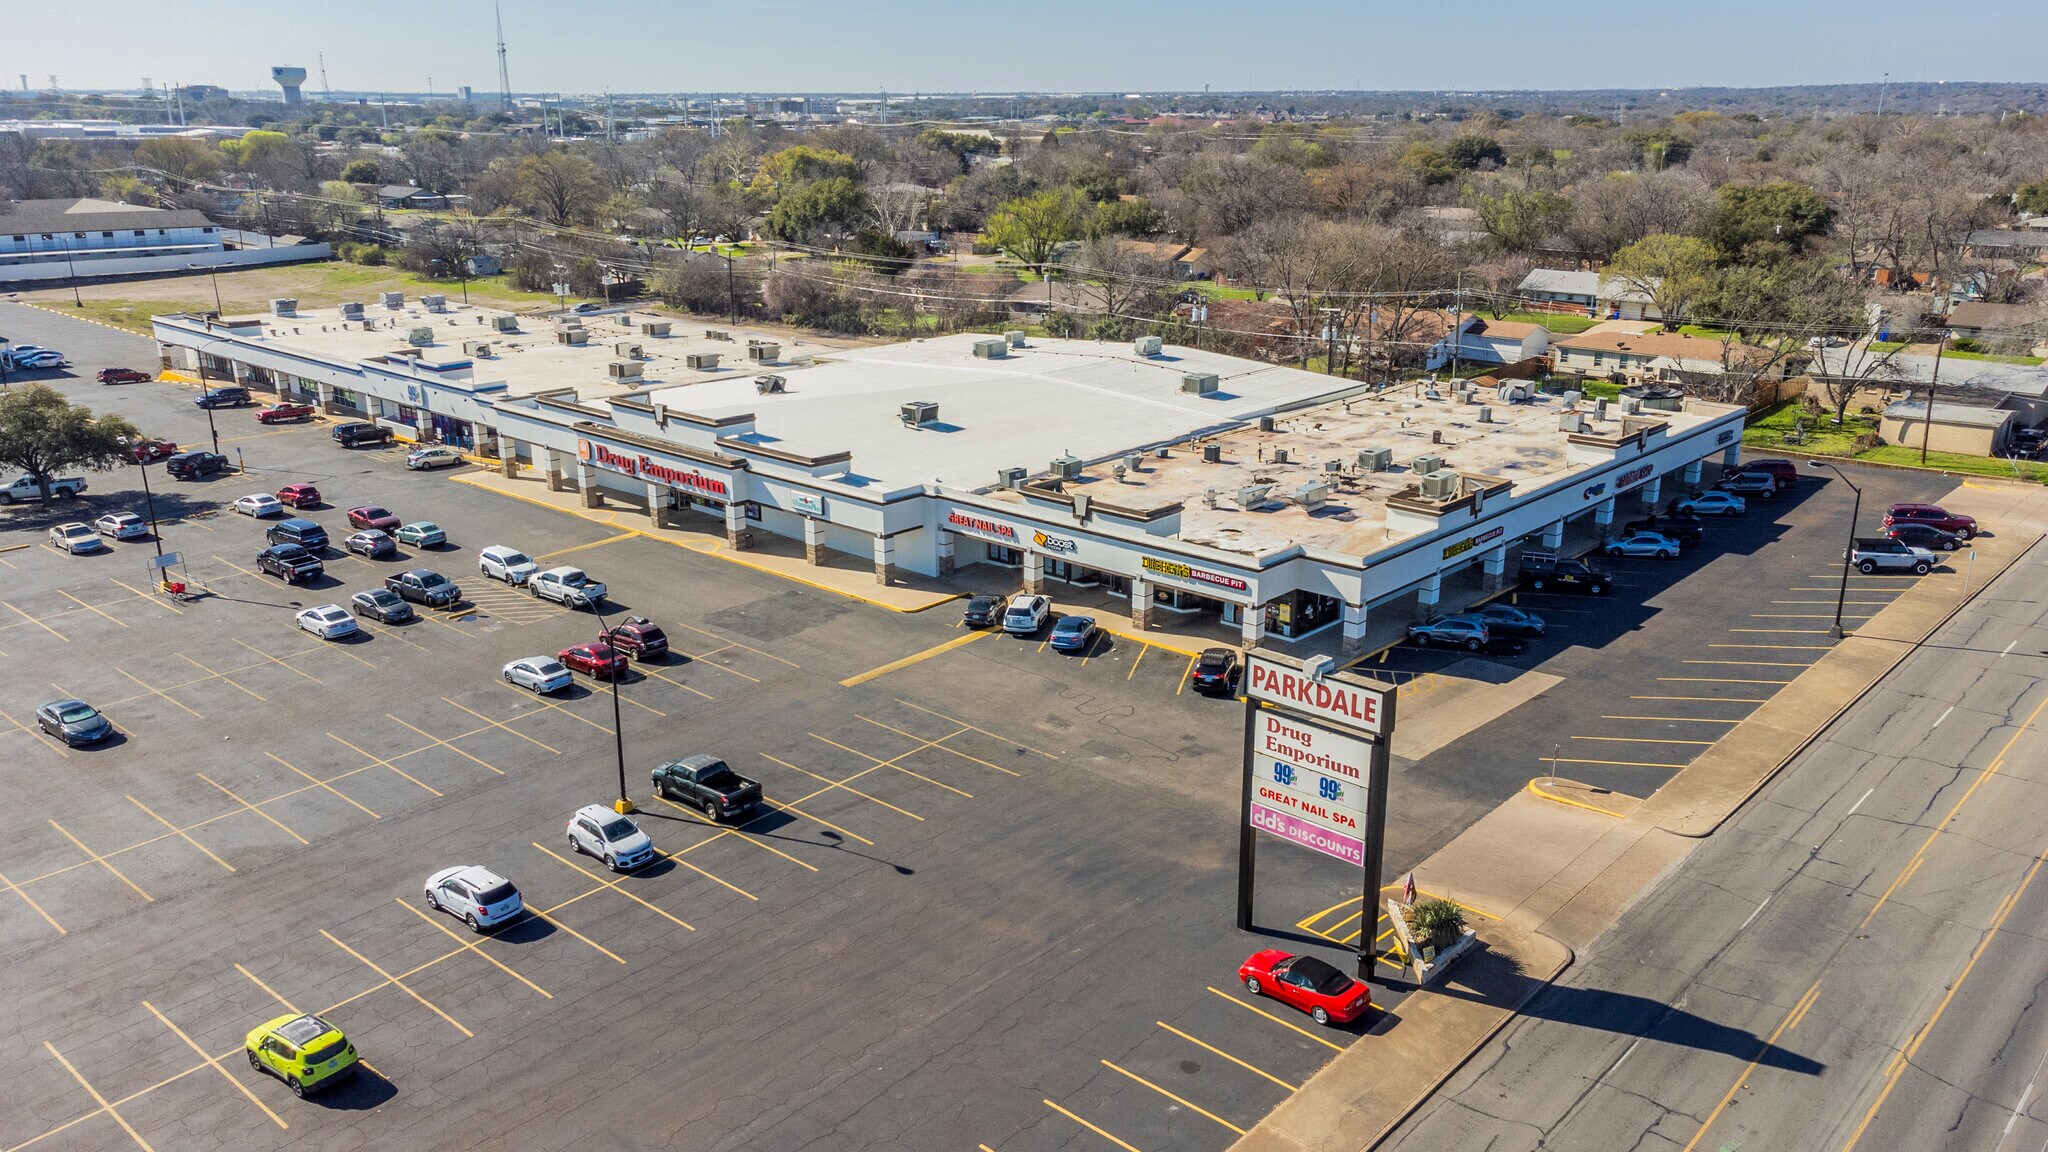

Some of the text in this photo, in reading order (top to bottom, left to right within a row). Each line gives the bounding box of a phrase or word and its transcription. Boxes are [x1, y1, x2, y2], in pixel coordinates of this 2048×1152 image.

[595, 444, 726, 494] Drug Emporium
[948, 512, 1014, 538] GREAT NAIL SPA
[1047, 535, 1074, 550] boost
[1191, 569, 1230, 585] BARBECUE
[1230, 580, 1244, 588] PIT
[1252, 664, 1377, 724] PARKDALE
[1267, 717, 1312, 747] Drug
[1266, 735, 1360, 779] Emporium
[1259, 786, 1357, 829] GREAT NAIL SPA
[1254, 809, 1361, 861] dd's DISCOUNTS
